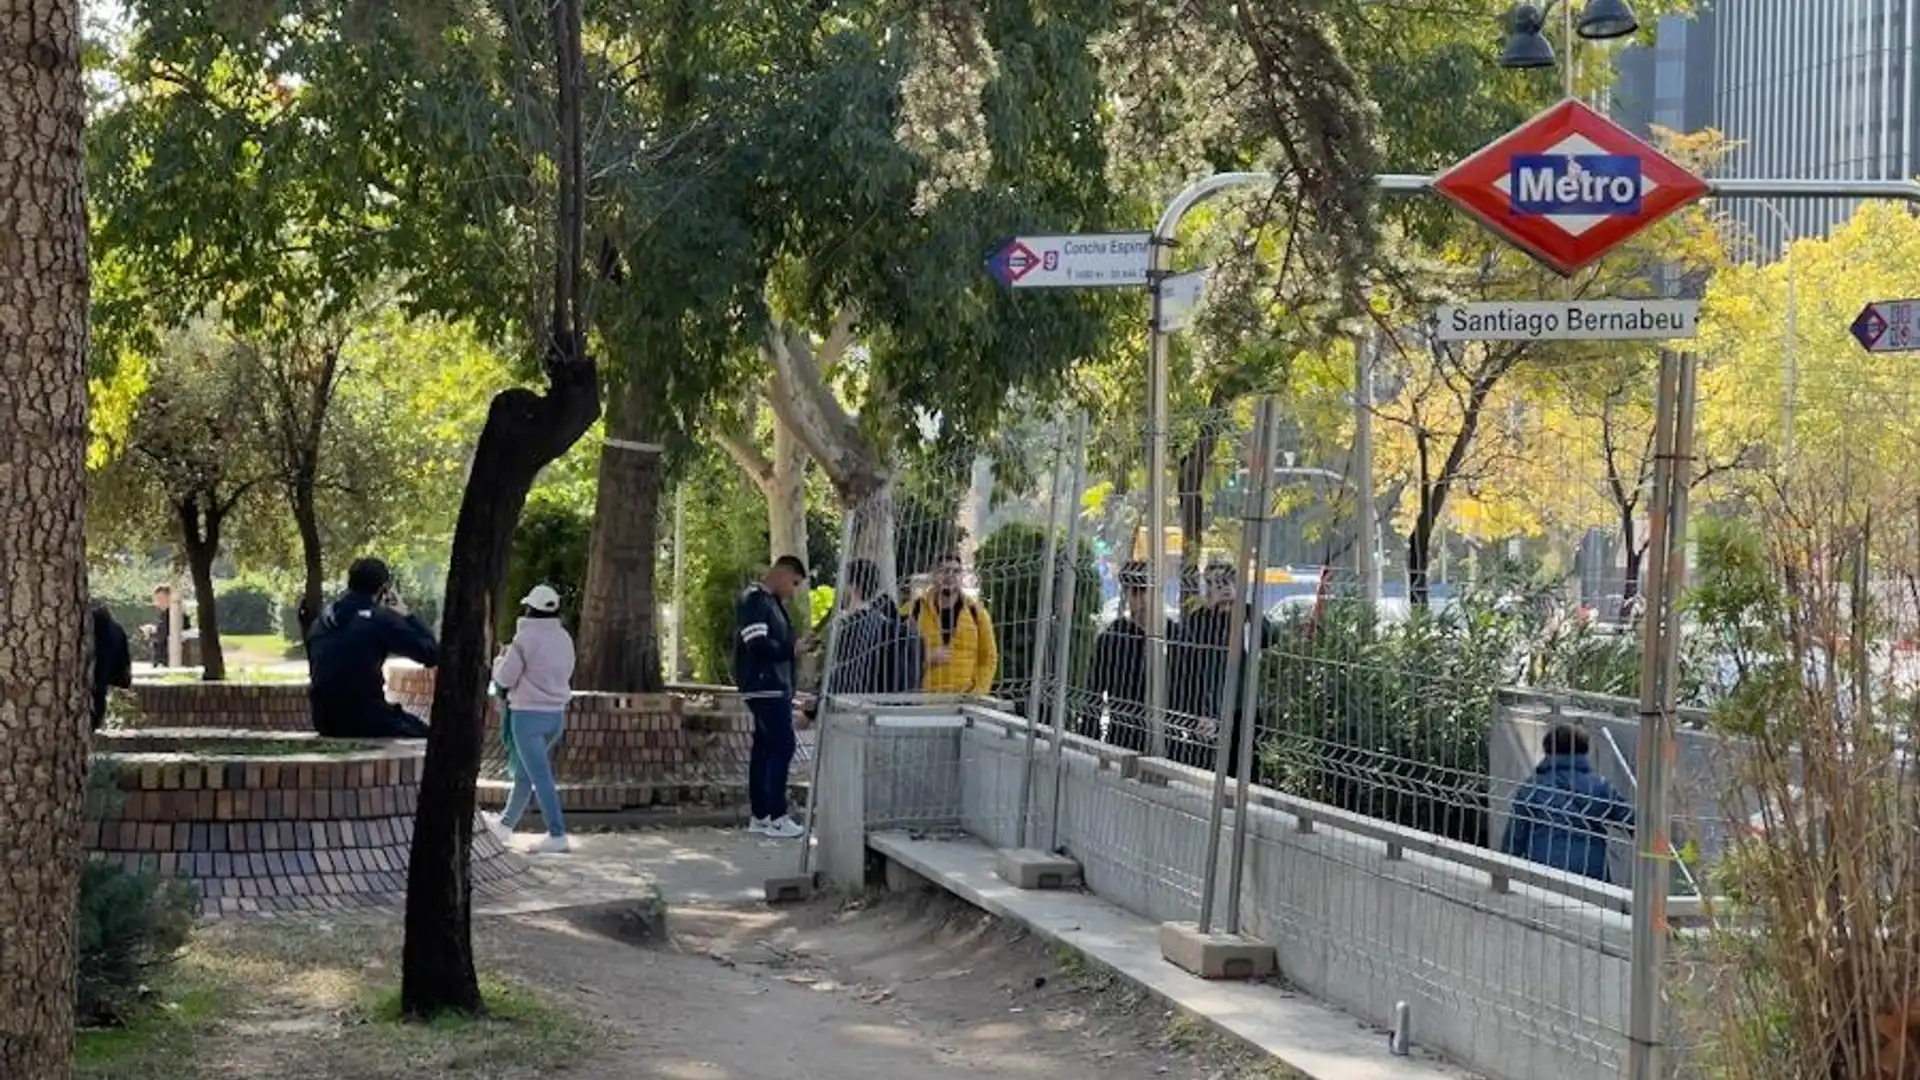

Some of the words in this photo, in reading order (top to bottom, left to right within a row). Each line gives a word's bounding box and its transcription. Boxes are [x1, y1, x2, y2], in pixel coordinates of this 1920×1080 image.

[1519, 167, 1635, 203] Metro
[1064, 241, 1106, 254] Concha
[1452, 308, 1559, 337] Santiago
[1567, 307, 1684, 330] Bernabeu
